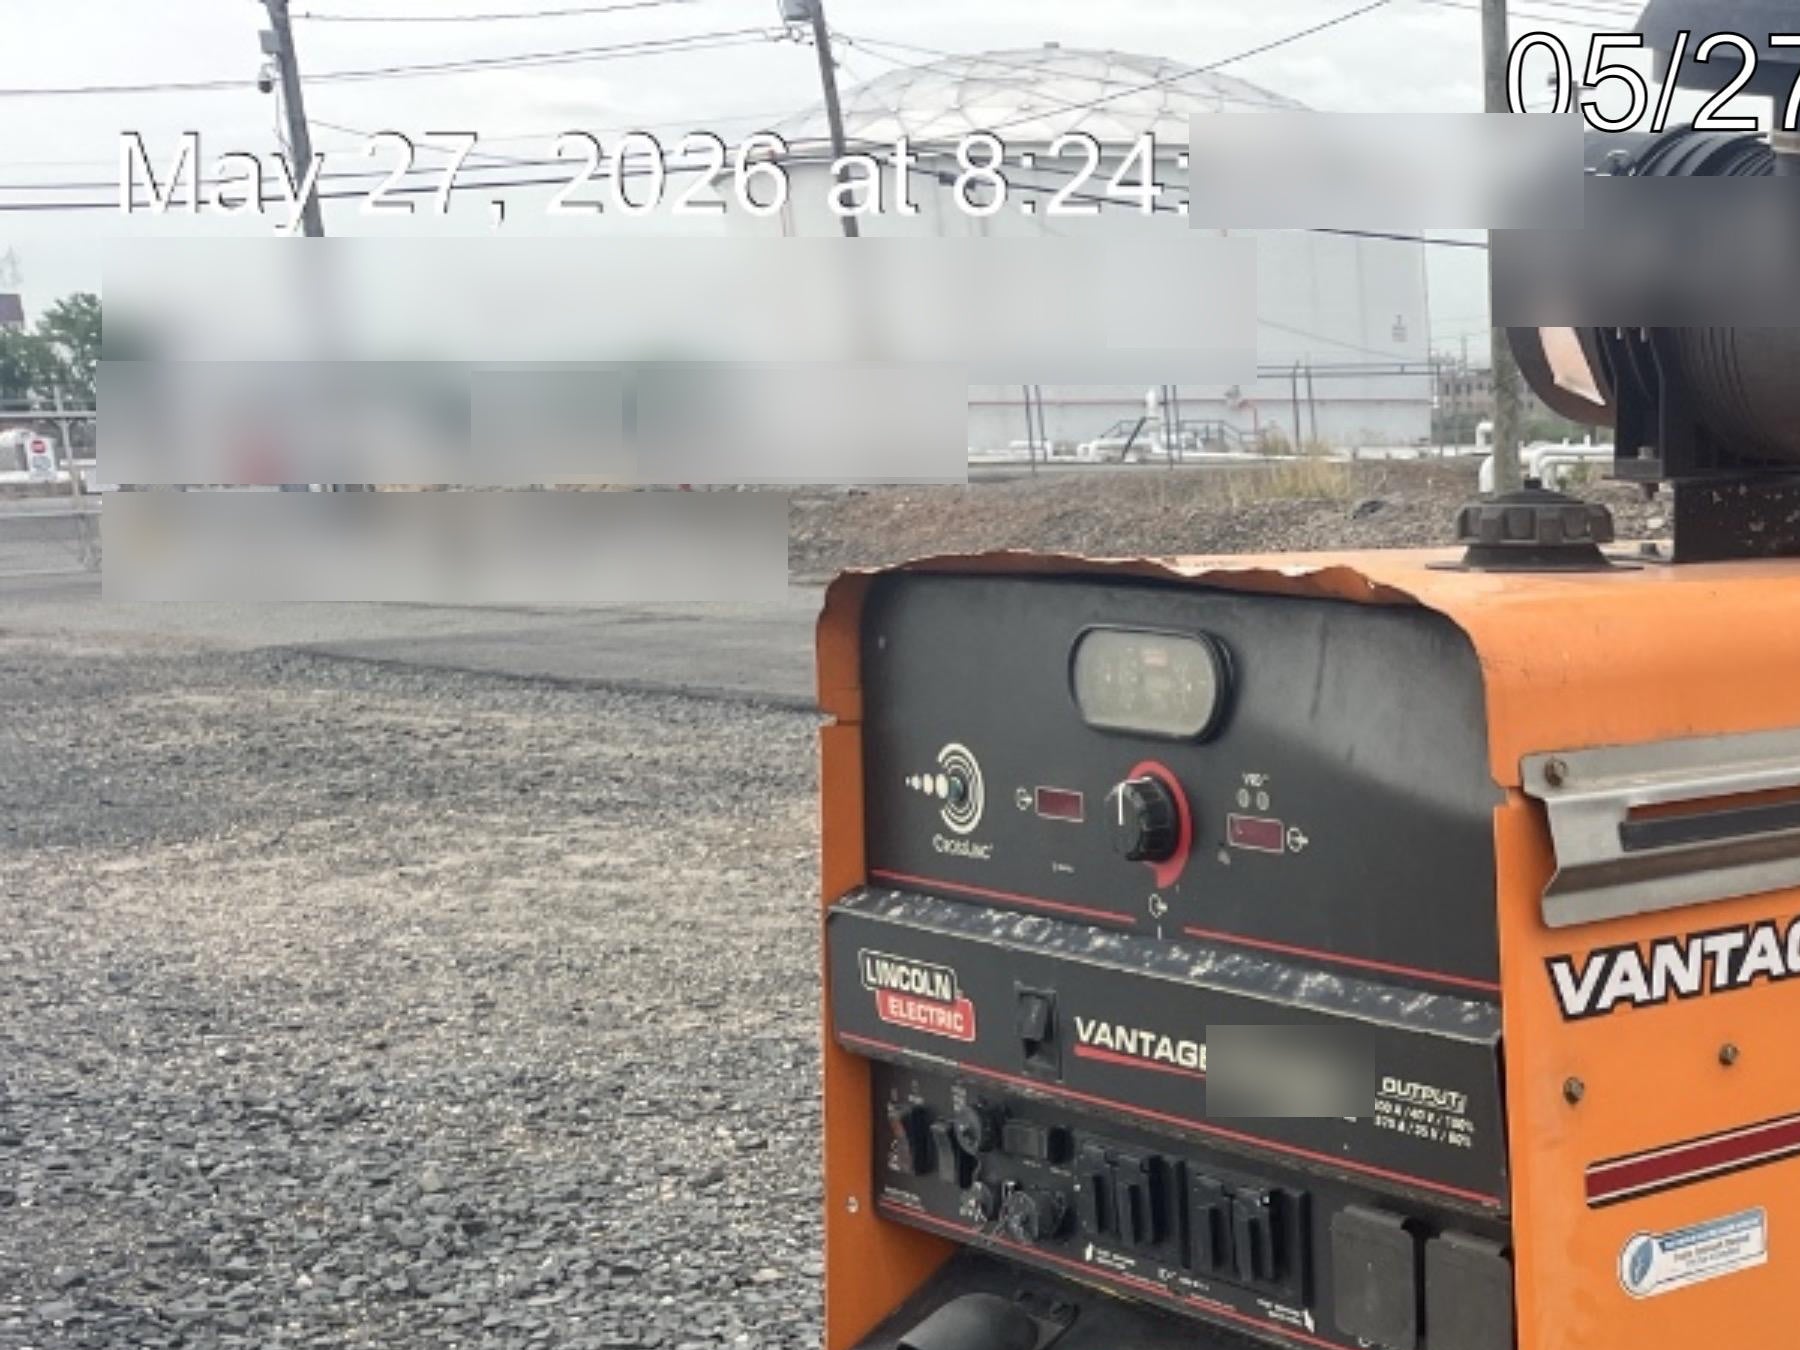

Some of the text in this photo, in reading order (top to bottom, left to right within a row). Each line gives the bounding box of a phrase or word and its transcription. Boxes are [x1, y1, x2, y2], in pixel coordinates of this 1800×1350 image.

[866, 957, 952, 1002] LINCOLN
[888, 996, 964, 1033] ELECTRIC
[1382, 1077, 1460, 1108] OUTPUT
